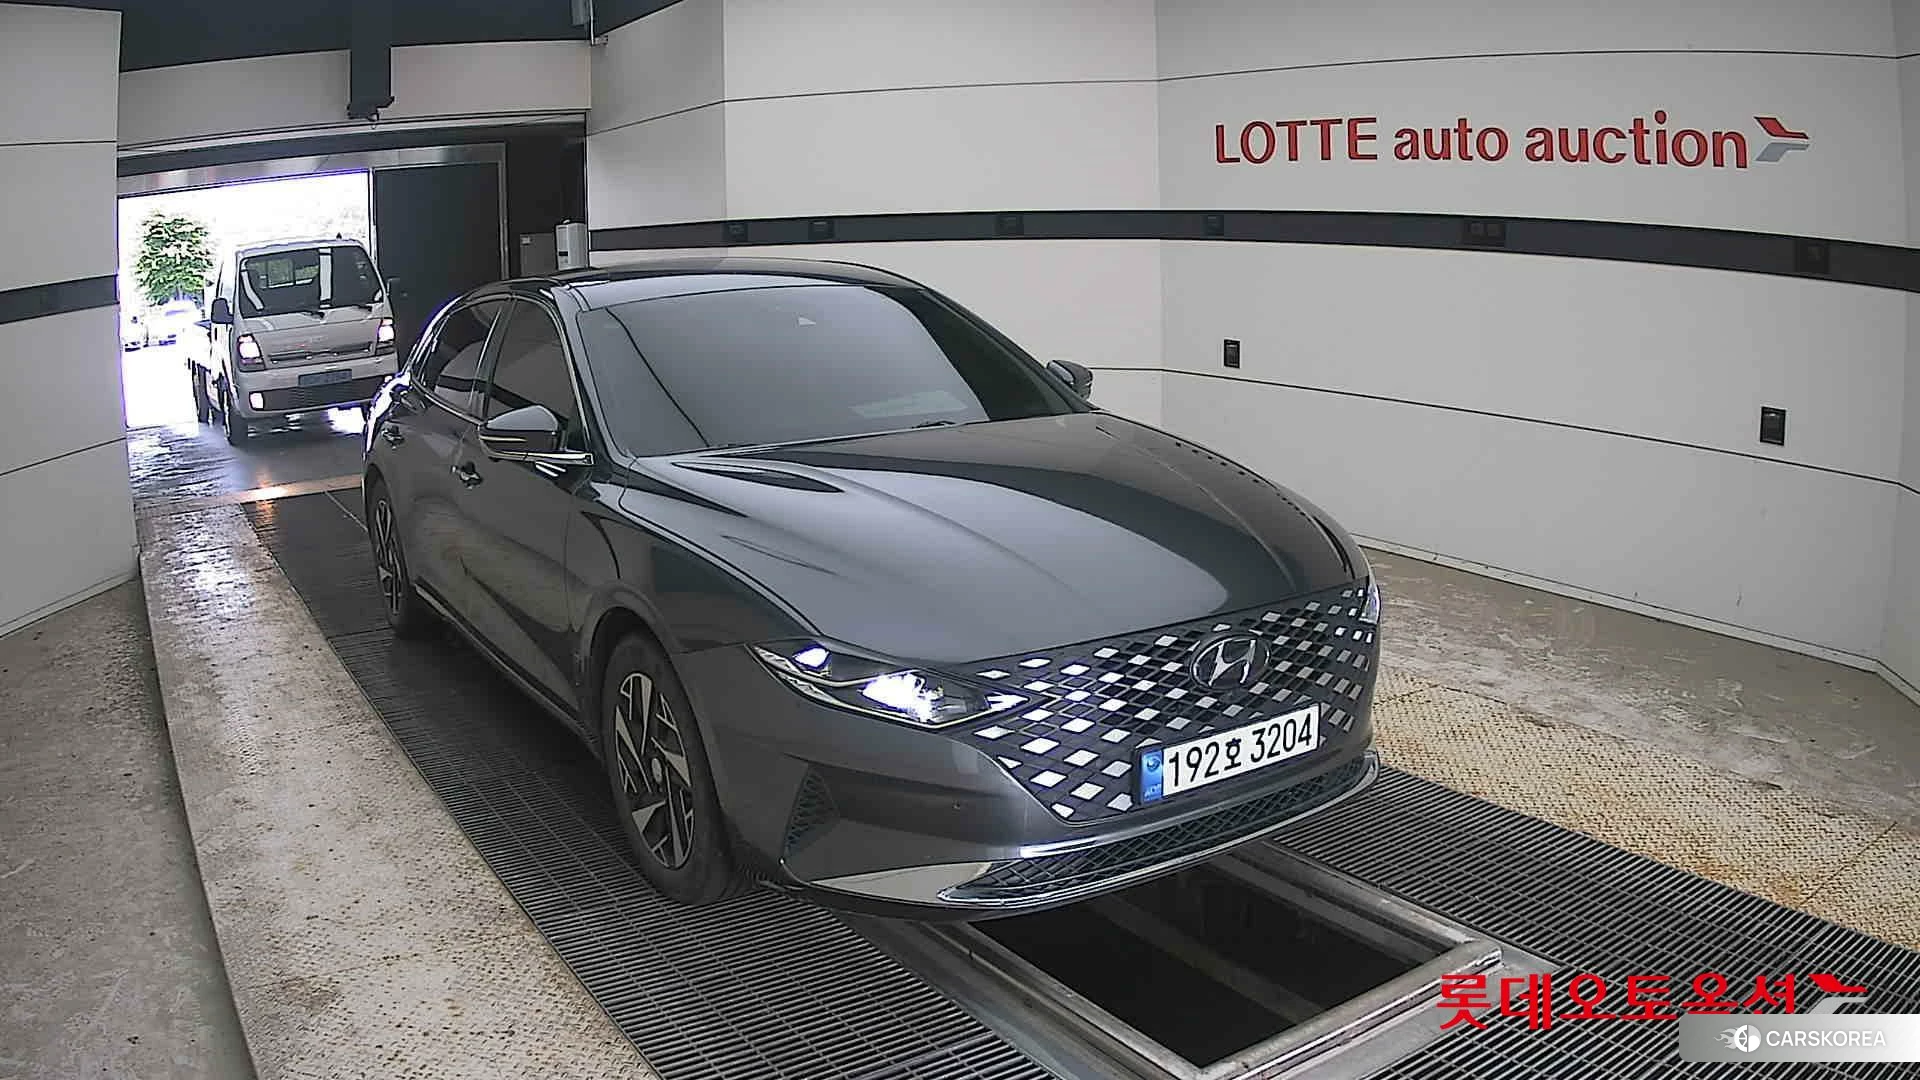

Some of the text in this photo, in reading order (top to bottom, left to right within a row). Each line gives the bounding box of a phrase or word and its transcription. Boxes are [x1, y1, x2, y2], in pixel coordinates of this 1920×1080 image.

[1215, 110, 1749, 169] LOTTE auto auction
[1168, 712, 1313, 788] 192호 3204
